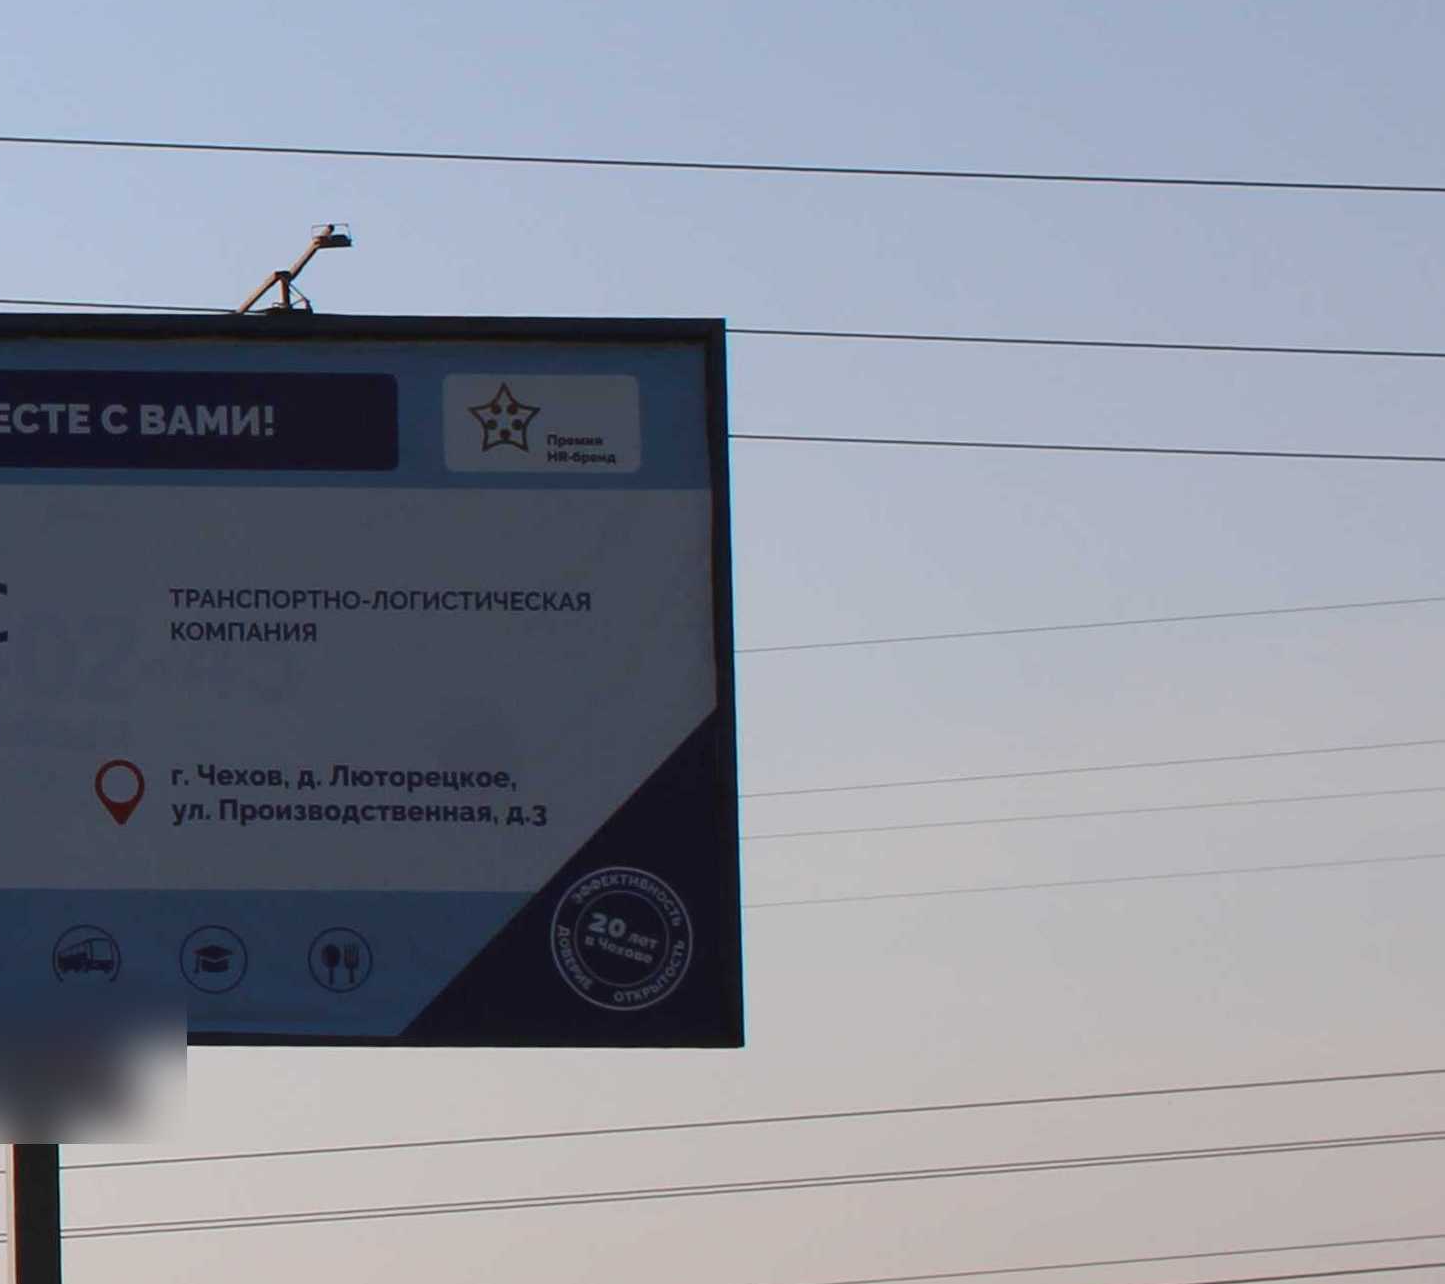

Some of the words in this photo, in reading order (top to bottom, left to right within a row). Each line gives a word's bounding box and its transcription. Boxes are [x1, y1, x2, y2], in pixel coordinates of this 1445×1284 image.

[101, 404, 129, 435] С
[140, 405, 275, 436] ВАМИ!
[546, 434, 603, 447] Премия
[169, 587, 592, 612] ТРАНСПОРТНО-ЛОГИСТИЧЕСКАЯ
[170, 621, 318, 643] КОМПАНИЯ
[170, 770, 189, 787] г.
[197, 765, 289, 789] Чехов,
[297, 769, 322, 790] д.
[329, 765, 517, 792] Люторецкое,
[171, 802, 211, 825] ул.
[219, 799, 499, 825] Производственная,
[506, 804, 547, 826] д.3
[573, 874, 682, 927] ЭФФЕКТИВНОСТЬ
[588, 912, 627, 938] 20
[627, 933, 659, 950] лет
[557, 924, 594, 990] ДОВЕРИЕ
[613, 939, 686, 1003] ОТКРЫТОСТЬ
